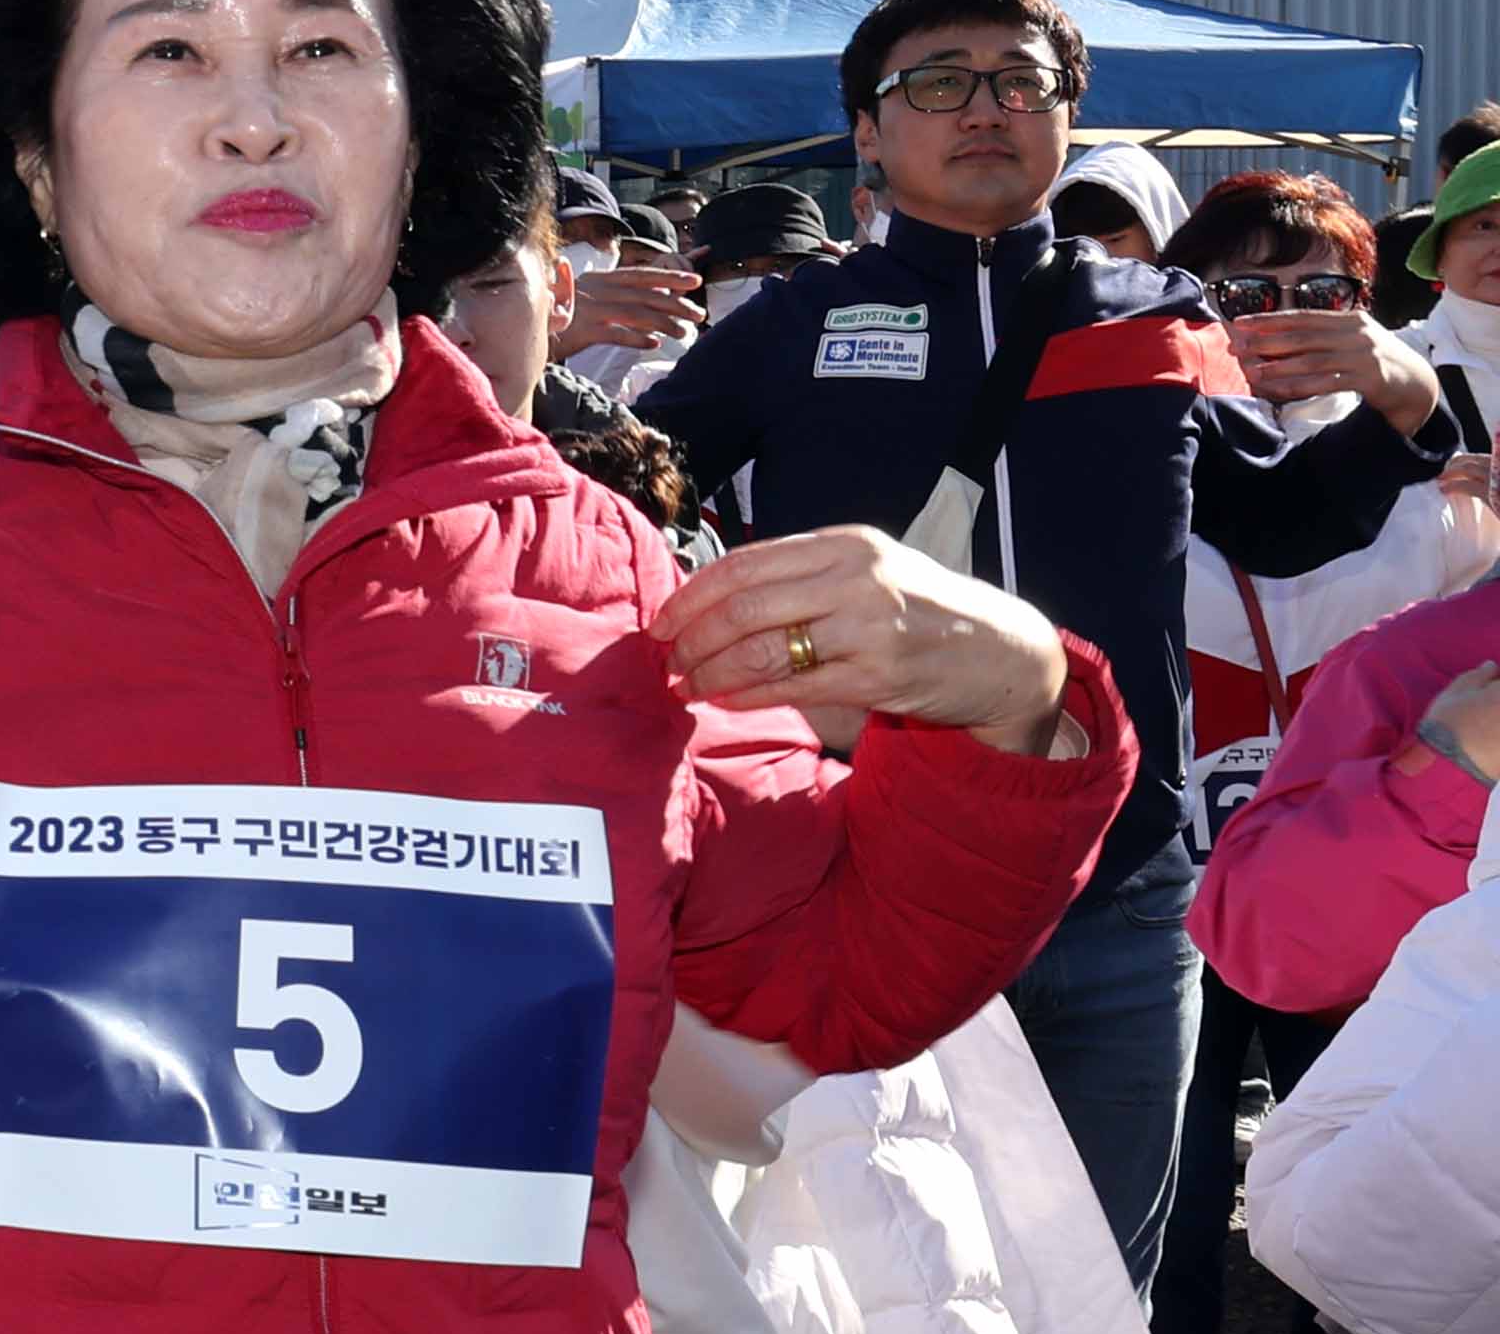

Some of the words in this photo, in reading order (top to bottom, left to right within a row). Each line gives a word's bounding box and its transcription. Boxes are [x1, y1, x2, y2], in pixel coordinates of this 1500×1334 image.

[859, 311, 902, 323] SYSTEM
[1219, 748, 1244, 763] 구
[8, 814, 124, 855] 2023
[136, 816, 221, 855] 동구
[233, 817, 580, 879] 구민건강걷기대회
[232, 917, 364, 1115] 5
